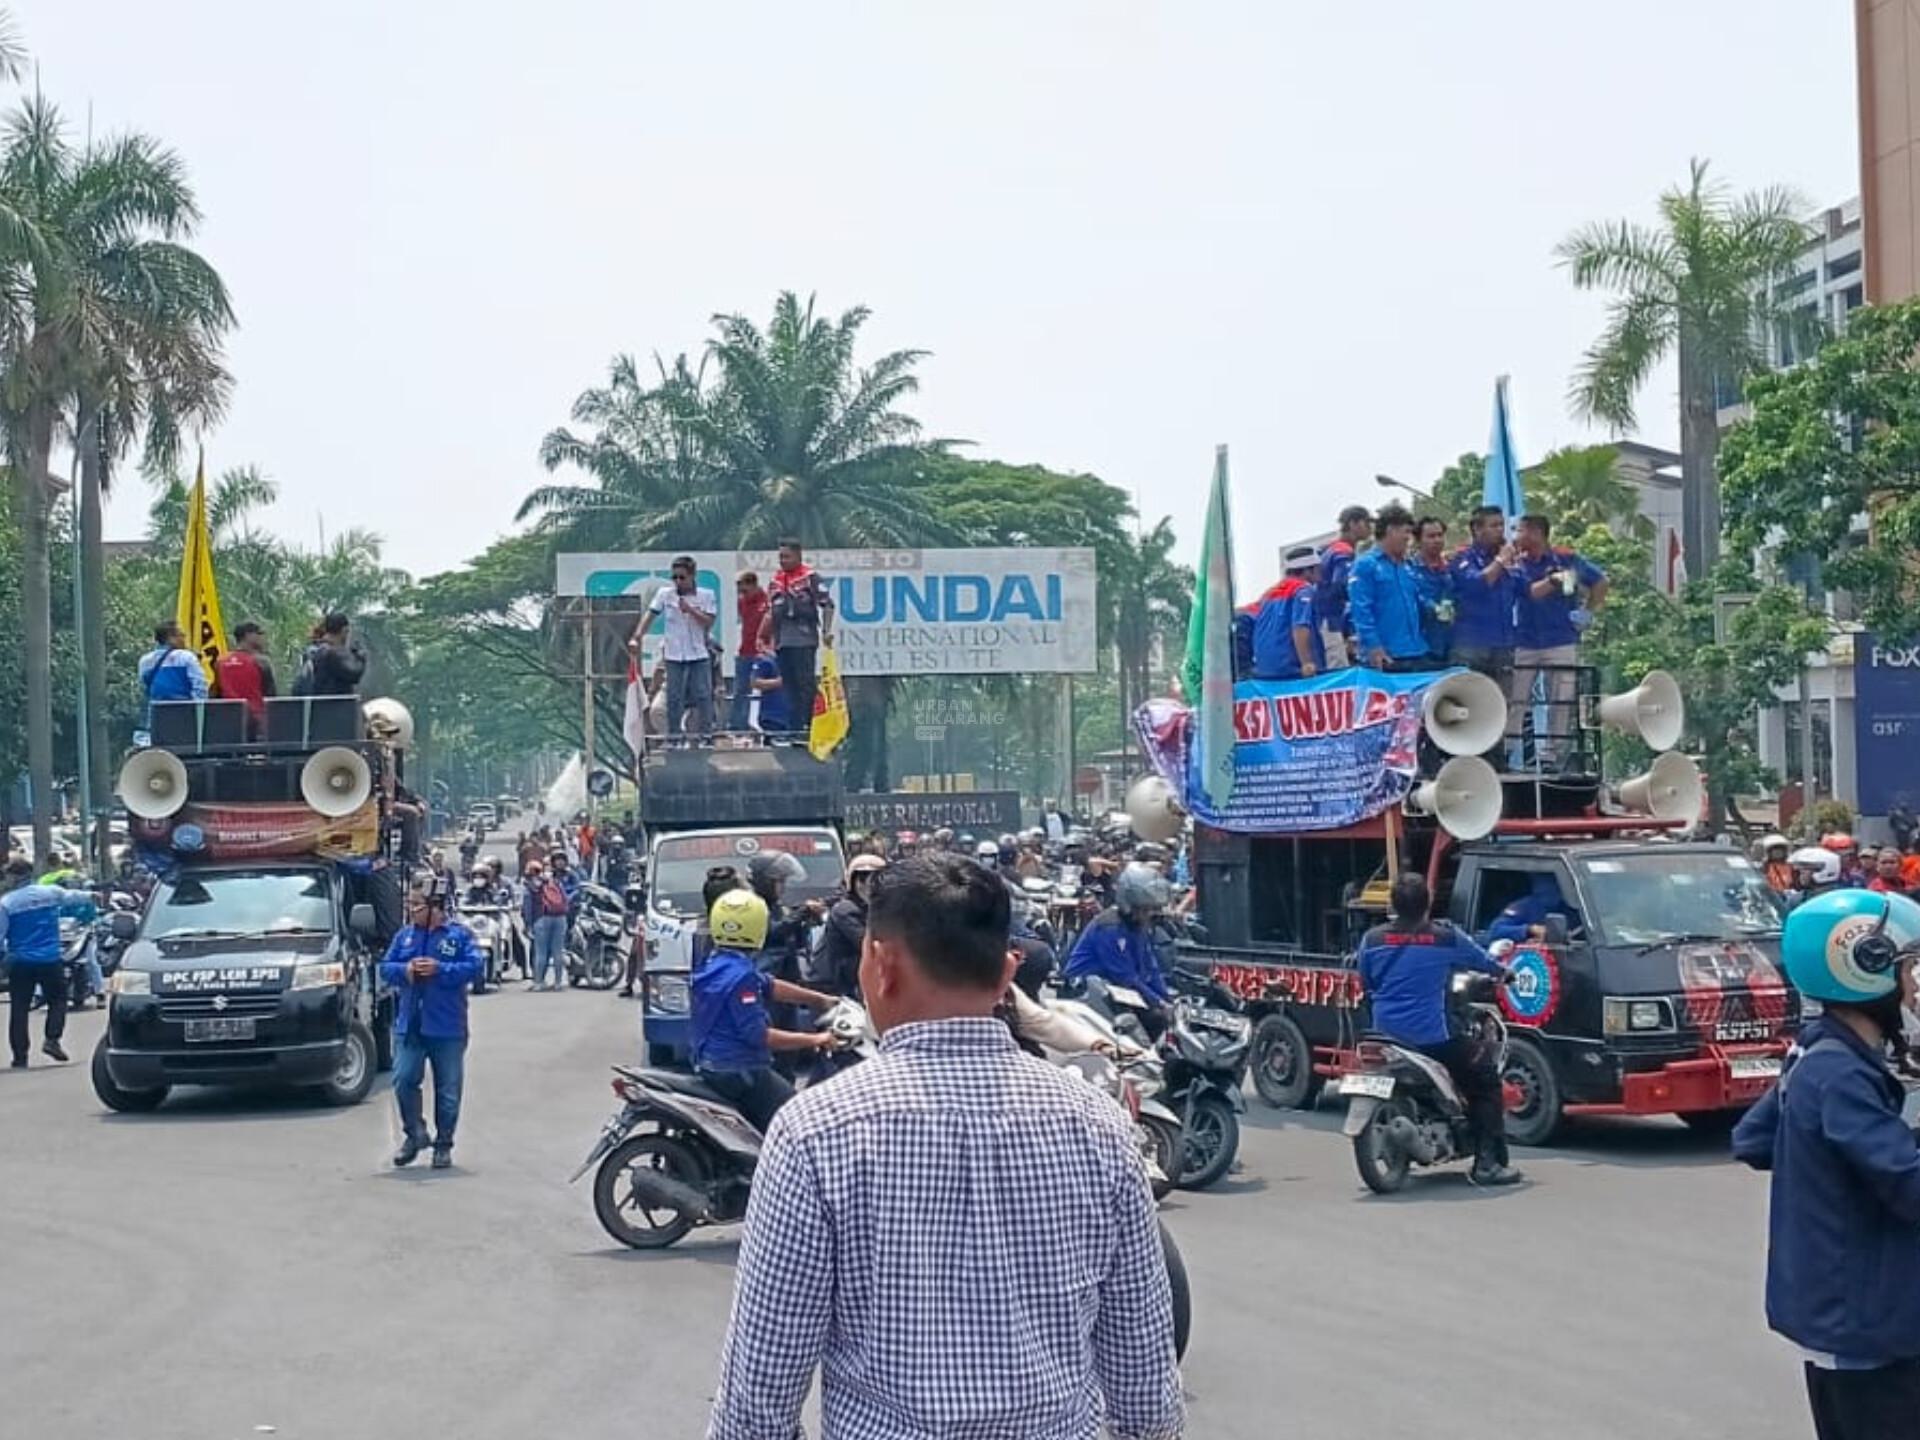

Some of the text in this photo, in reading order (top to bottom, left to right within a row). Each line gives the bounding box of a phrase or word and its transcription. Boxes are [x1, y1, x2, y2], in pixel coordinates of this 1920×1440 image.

[880, 552, 916, 568] TO
[827, 574, 1063, 623] UNDAI
[839, 625, 1058, 648] INTERNATIONAL
[1233, 697, 1274, 740] KSI
[844, 802, 1002, 827] INTERNATIONAL
[162, 971, 189, 984] DPC
